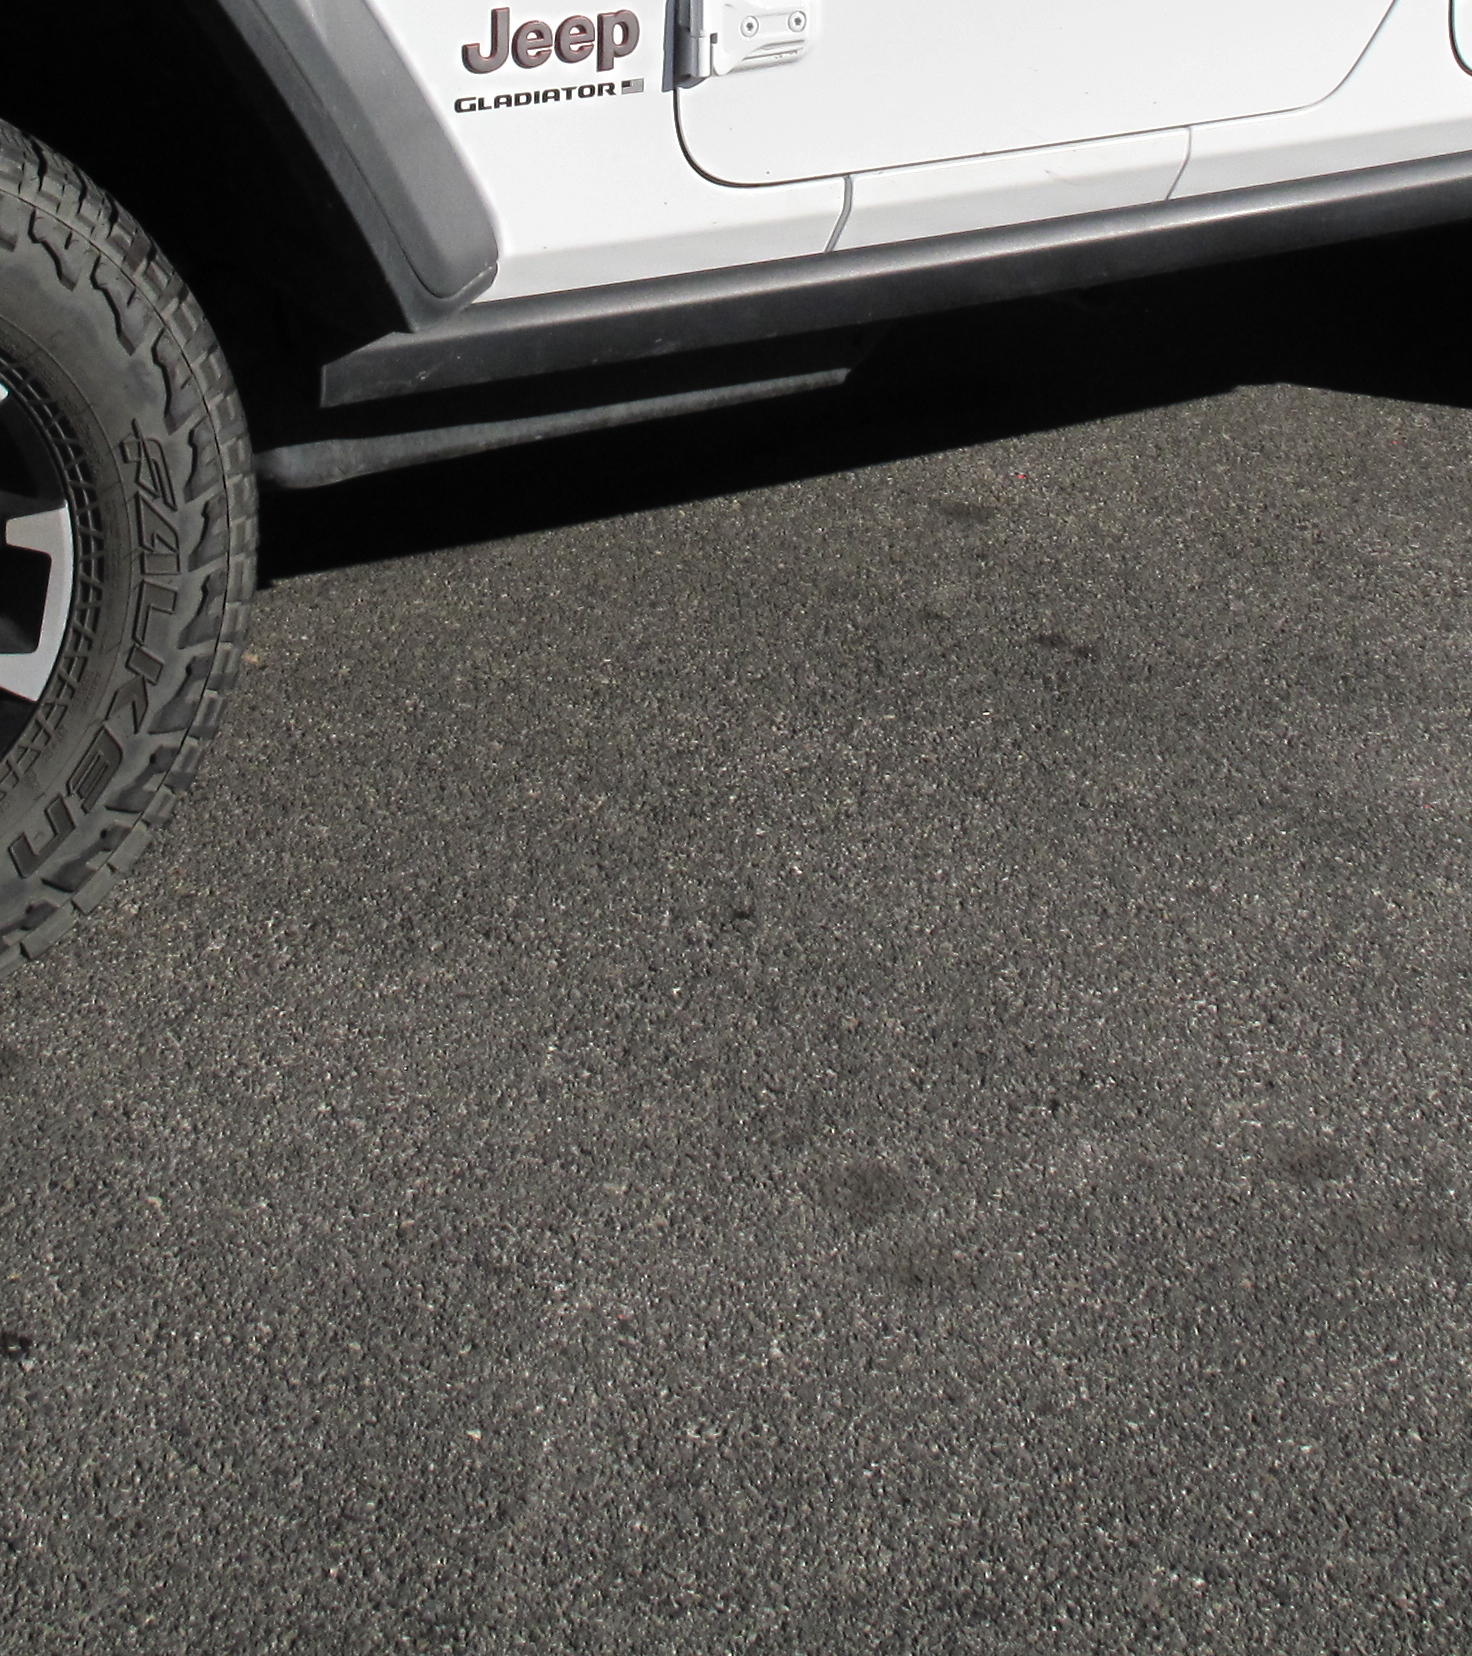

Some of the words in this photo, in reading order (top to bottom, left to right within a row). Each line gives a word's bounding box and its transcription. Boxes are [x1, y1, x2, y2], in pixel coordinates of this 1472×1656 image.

[461, 6, 641, 75] Jeep
[454, 82, 617, 114] GLADIATOR
[8, 417, 181, 880] FALKEN
